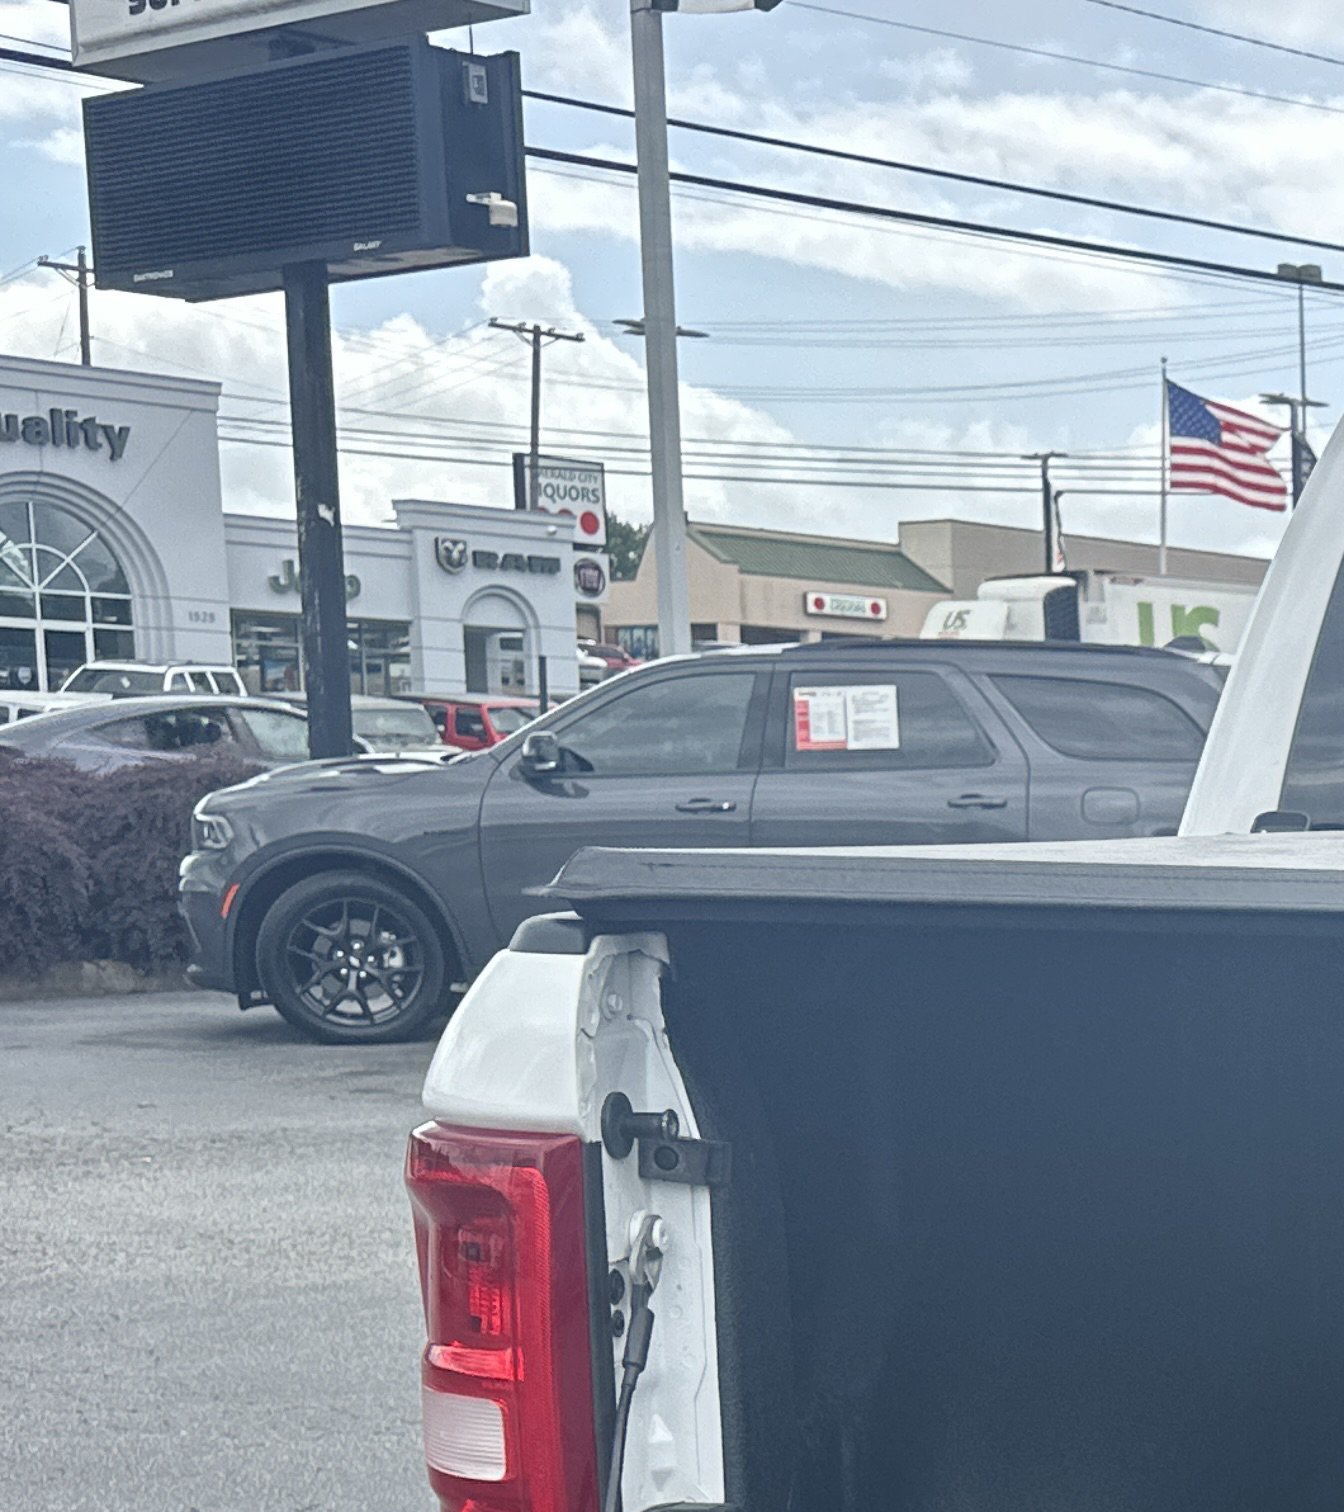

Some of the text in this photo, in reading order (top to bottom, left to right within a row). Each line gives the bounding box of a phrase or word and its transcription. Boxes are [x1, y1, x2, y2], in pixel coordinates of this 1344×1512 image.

[577, 471, 599, 484] CITY
[537, 481, 600, 504] IQUORS
[472, 550, 562, 576] RAM
[268, 558, 361, 601] Jp
